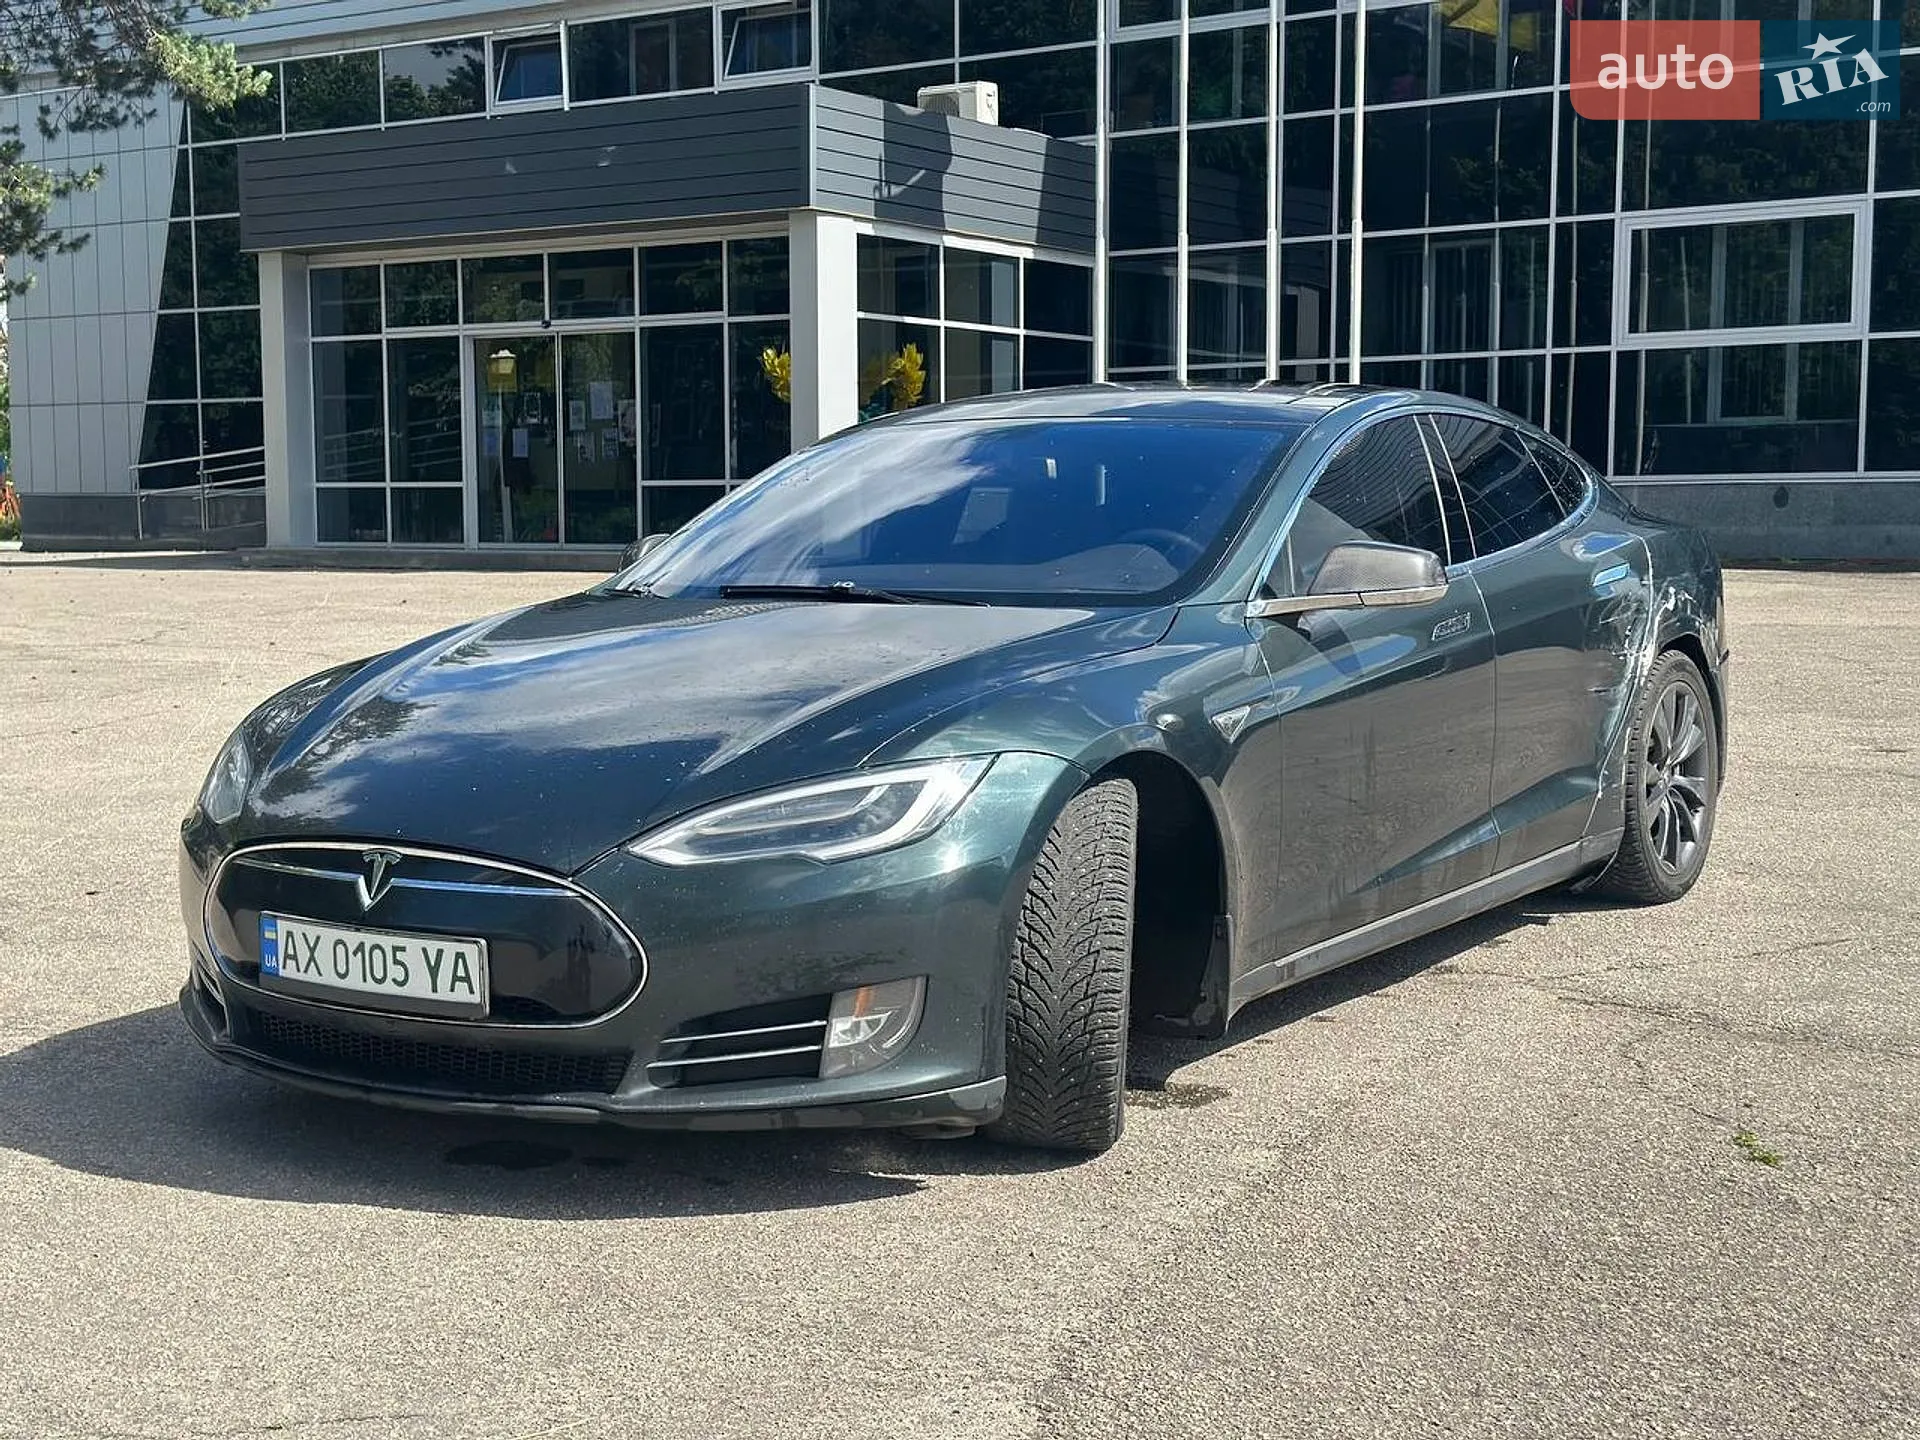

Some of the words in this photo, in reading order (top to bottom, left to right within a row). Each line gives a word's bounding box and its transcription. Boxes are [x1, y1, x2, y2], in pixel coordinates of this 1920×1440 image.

[265, 953, 278, 968] UA
[282, 930, 323, 977] AX
[333, 938, 410, 988] 0105
[421, 946, 475, 995] YA
